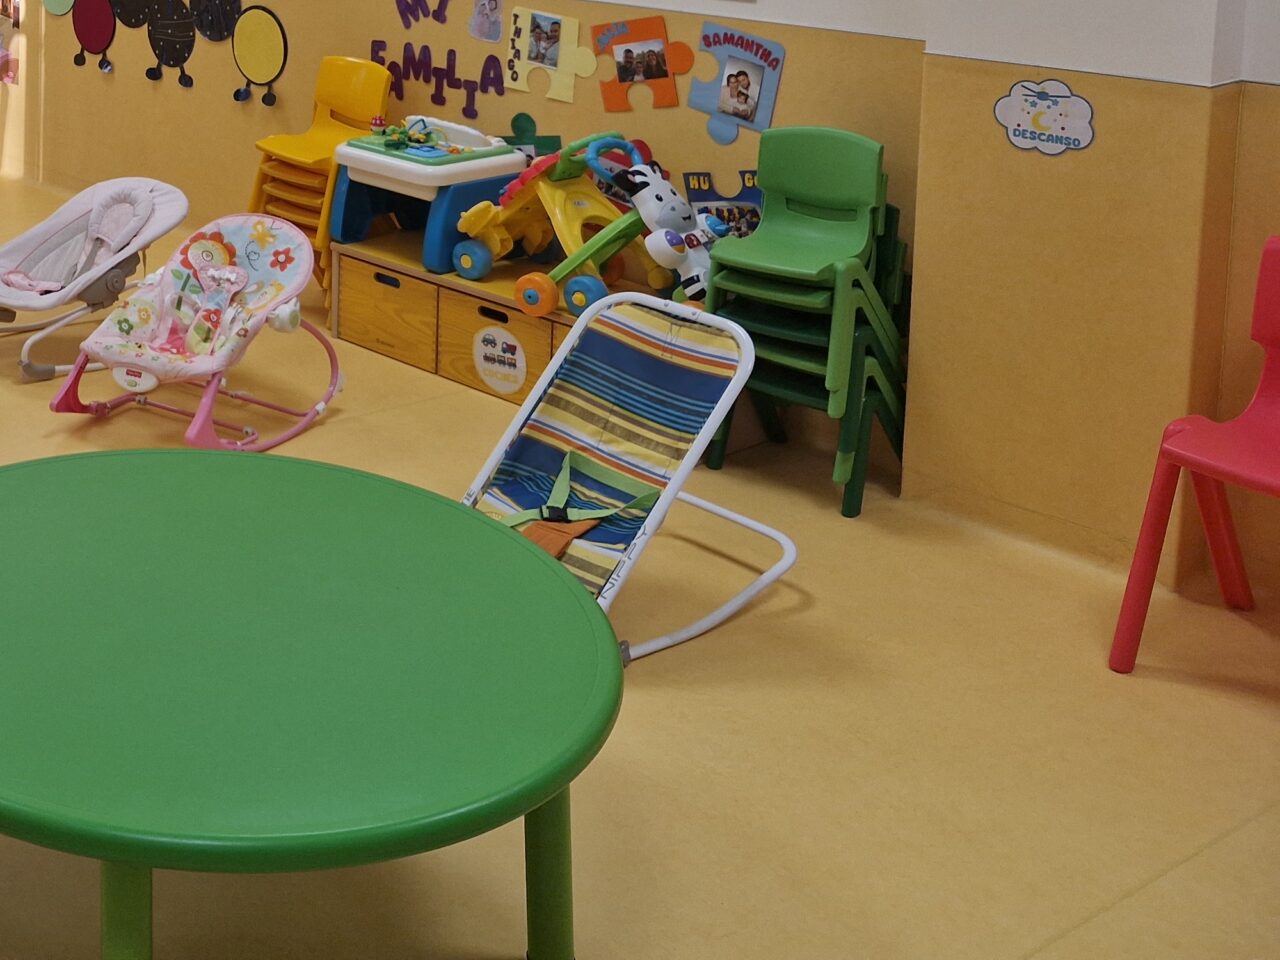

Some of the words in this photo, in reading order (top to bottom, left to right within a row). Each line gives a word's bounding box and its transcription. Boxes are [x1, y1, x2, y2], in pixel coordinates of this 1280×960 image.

[508, 14, 523, 82] THIAGO
[702, 32, 780, 71] SAMANTHA
[371, 40, 505, 119] FAMILIA
[1012, 128, 1081, 147] DESCANSO
